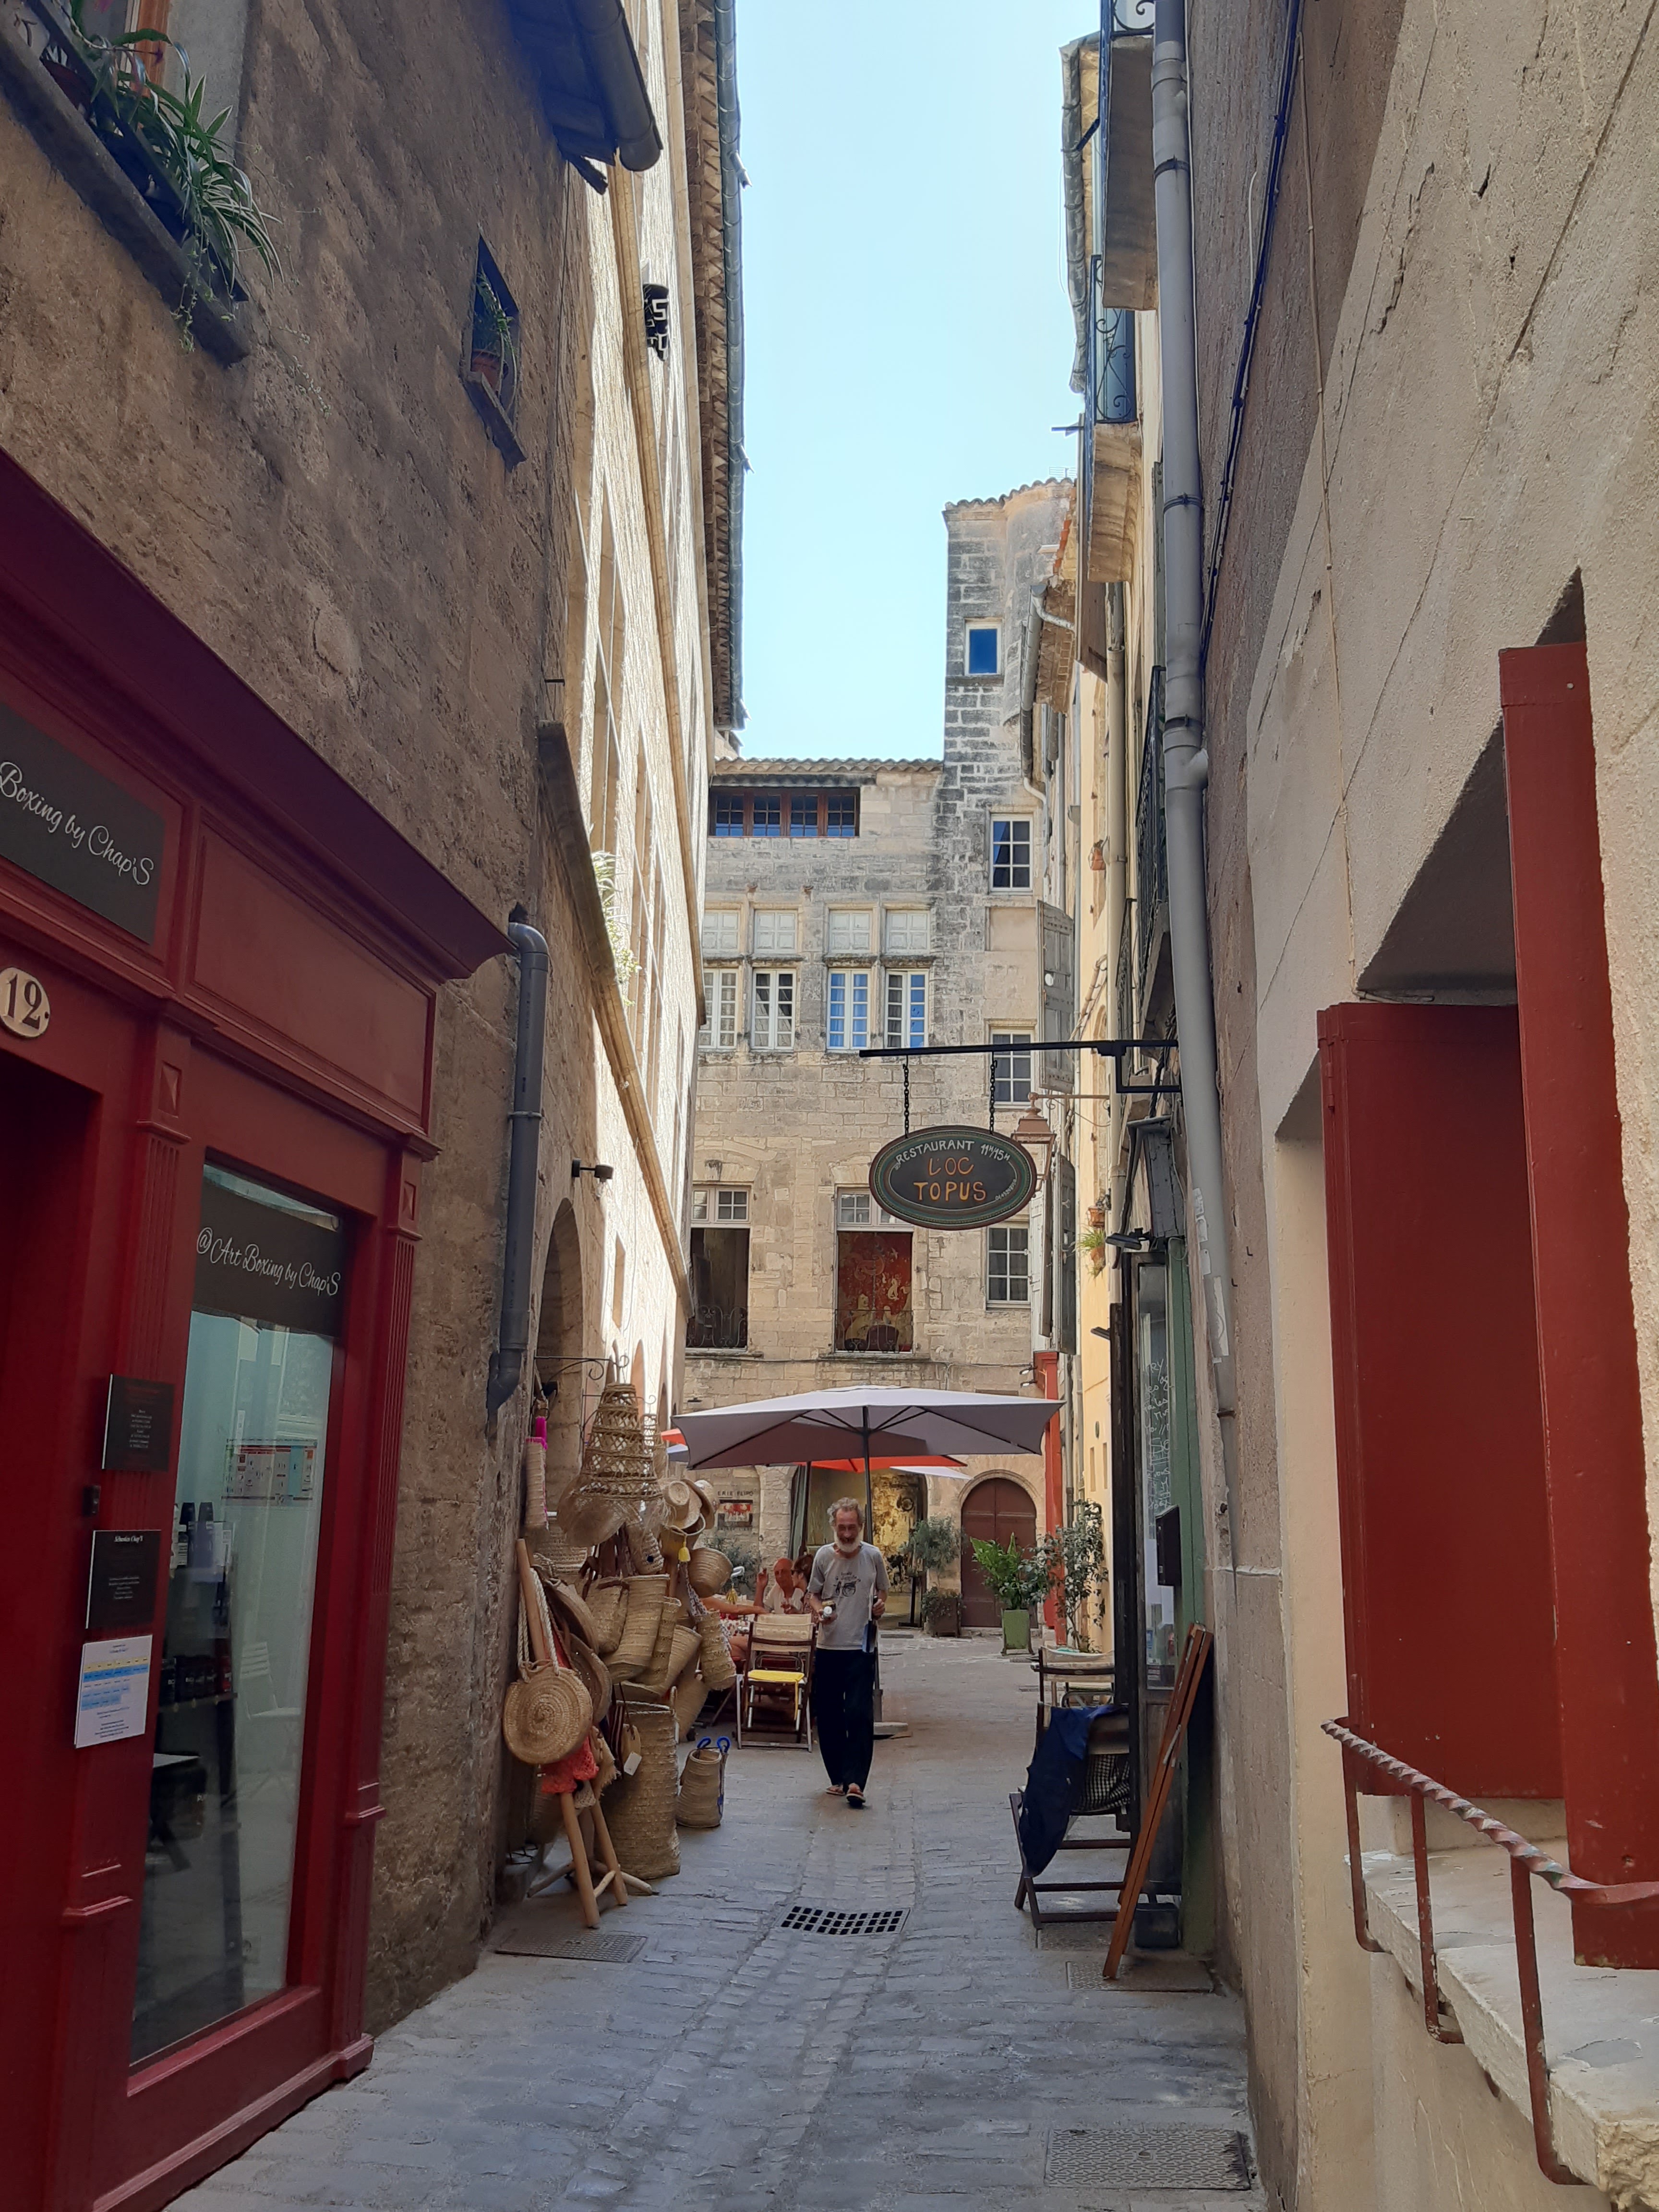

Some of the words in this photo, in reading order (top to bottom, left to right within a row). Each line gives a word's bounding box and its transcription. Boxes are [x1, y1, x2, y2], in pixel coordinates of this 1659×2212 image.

[0, 761, 63, 833] Boxing
[65, 815, 85, 849] by
[88, 825, 154, 885] Chap'S
[4, 974, 42, 1030] 12
[896, 1139, 975, 1164] RESTAURANT
[928, 1156, 974, 1176] L'OC
[914, 1181, 986, 1201] TOPUS
[242, 1244, 284, 1286] Boxing
[285, 1263, 297, 1289] by
[299, 1262, 341, 1296] Chap'S
